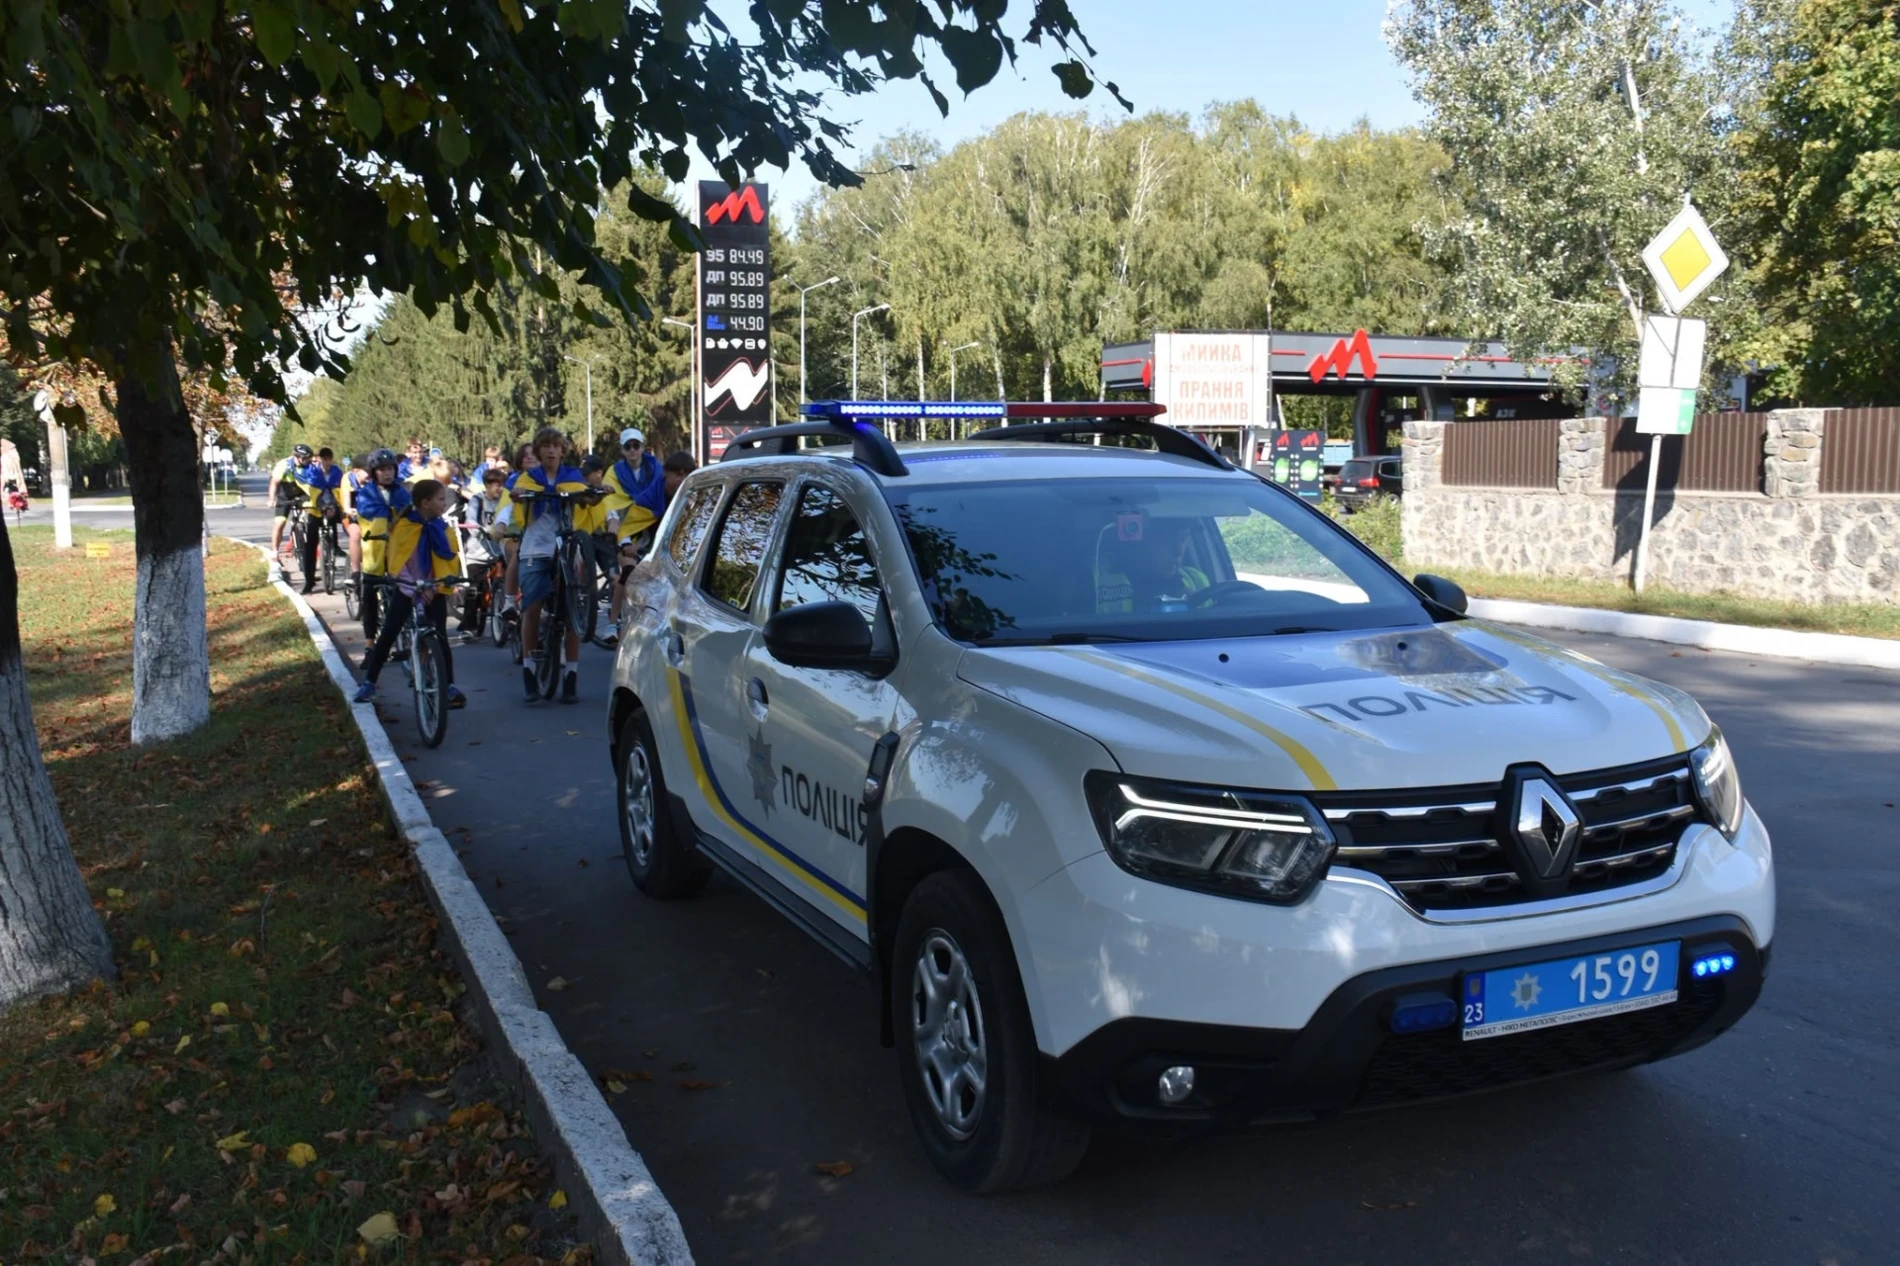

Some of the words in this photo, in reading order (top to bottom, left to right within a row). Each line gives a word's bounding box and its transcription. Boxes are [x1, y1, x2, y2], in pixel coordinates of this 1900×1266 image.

[1179, 381, 1244, 399] ПРАННЯ
[1173, 402, 1249, 421] КИЛИМІВ
[1298, 685, 1578, 722] ПОЛІЦІЯ
[782, 765, 868, 847] ПОЛІЦІЯ
[1570, 949, 1661, 1003] 1599
[1464, 1002, 1484, 1024] 23
